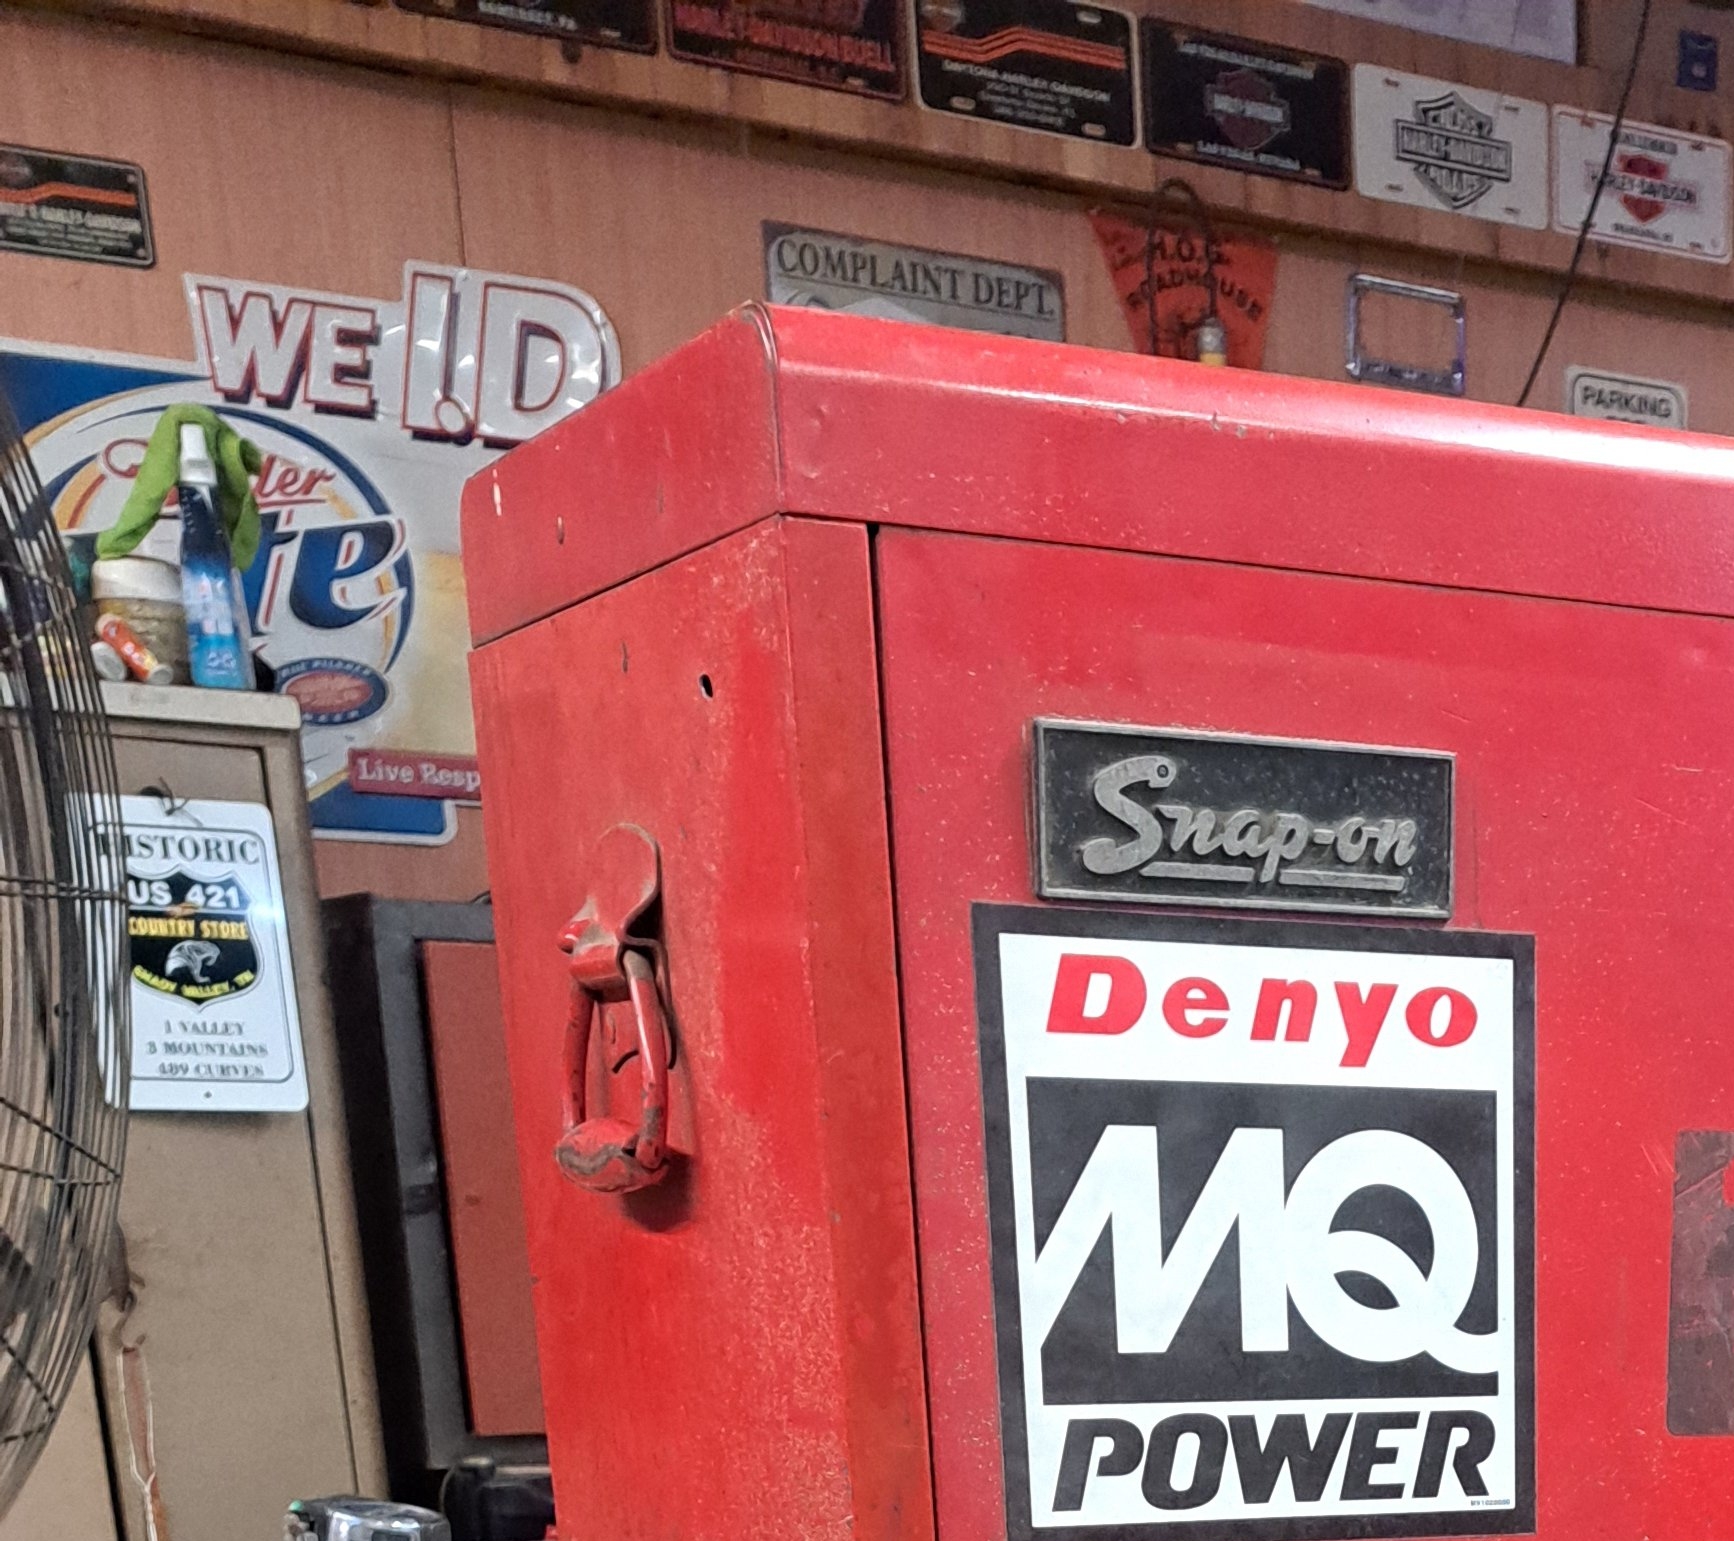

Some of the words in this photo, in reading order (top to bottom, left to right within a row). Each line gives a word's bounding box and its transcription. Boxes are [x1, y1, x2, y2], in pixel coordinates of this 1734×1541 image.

[776, 238, 966, 301] COMPLAINT
[970, 270, 1054, 317] DEPT.
[198, 284, 380, 419] WE
[1582, 385, 1672, 419] PARKING
[358, 757, 416, 783] Live
[1081, 755, 1417, 883] Snap-on
[127, 878, 173, 906] US
[186, 884, 242, 909] 421
[200, 917, 250, 941] STORE
[1045, 952, 1480, 1068] Denyo
[178, 1020, 246, 1036] VALLEY
[163, 1042, 269, 1057] MOUNTAINS
[194, 1064, 264, 1078] CURVES
[1024, 1122, 1500, 1376] MQ
[1052, 1410, 1497, 1513] POWER
